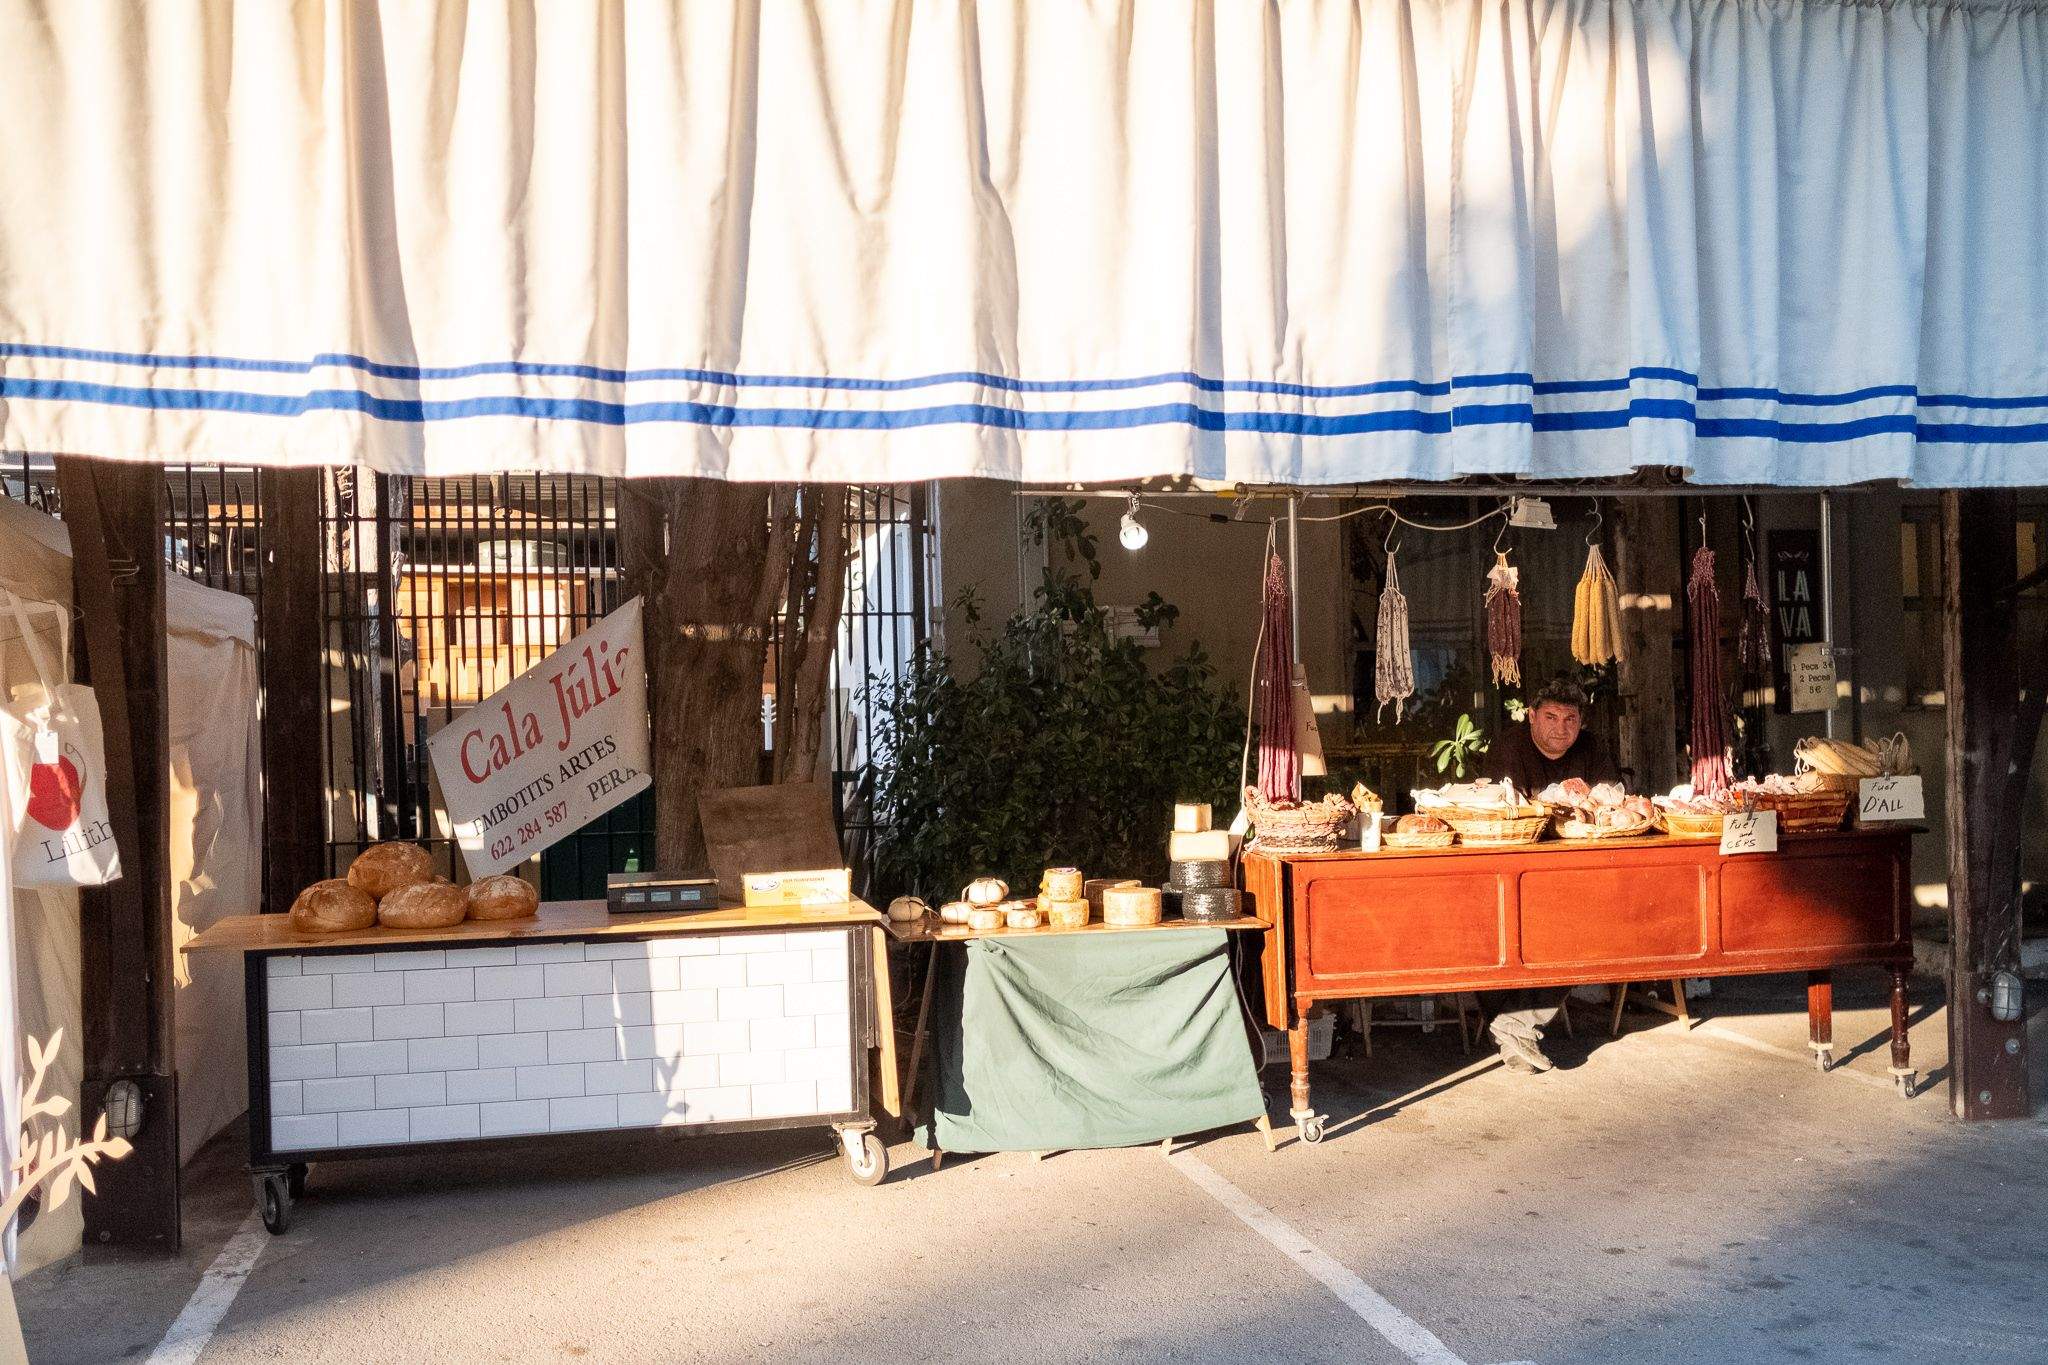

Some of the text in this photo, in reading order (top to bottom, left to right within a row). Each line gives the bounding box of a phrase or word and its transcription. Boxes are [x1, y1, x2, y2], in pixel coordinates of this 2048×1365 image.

[1778, 570, 1811, 602] LA
[1779, 606, 1812, 638] VA
[1792, 663, 1797, 672] 1
[1799, 674, 1805, 683] 2
[460, 700, 544, 785] Cala
[472, 773, 554, 838] EMBOTITS
[40, 820, 115, 863] Lilith
[490, 836, 515, 861] 622
[520, 817, 542, 845] 284
[544, 800, 569, 828] 587
